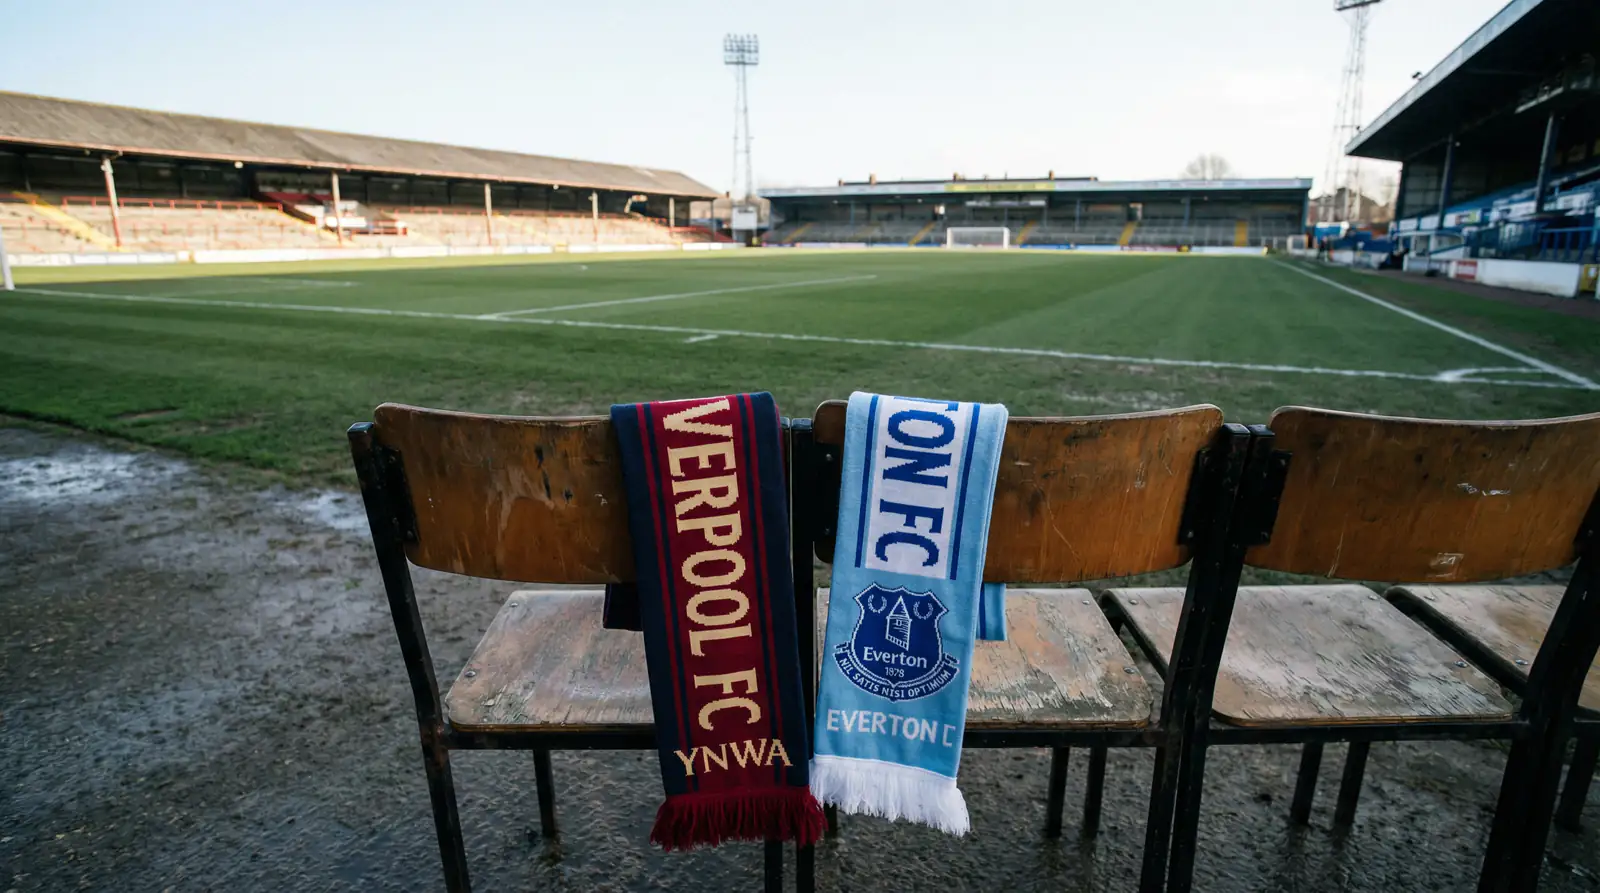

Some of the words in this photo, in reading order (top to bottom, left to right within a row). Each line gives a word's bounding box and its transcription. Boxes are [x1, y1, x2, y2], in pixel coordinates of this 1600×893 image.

[662, 397, 752, 657] VERPOOL
[875, 498, 945, 568] FC
[863, 646, 928, 669] Everton
[885, 667, 905, 678] 1878
[839, 658, 852, 675] NIL
[852, 673, 880, 692] SATIS
[881, 687, 905, 698] NISI
[907, 669, 952, 698] OPTIMUM
[693, 667, 762, 731] FC
[827, 708, 938, 744] EVERTON
[674, 738, 793, 776] YNWA
